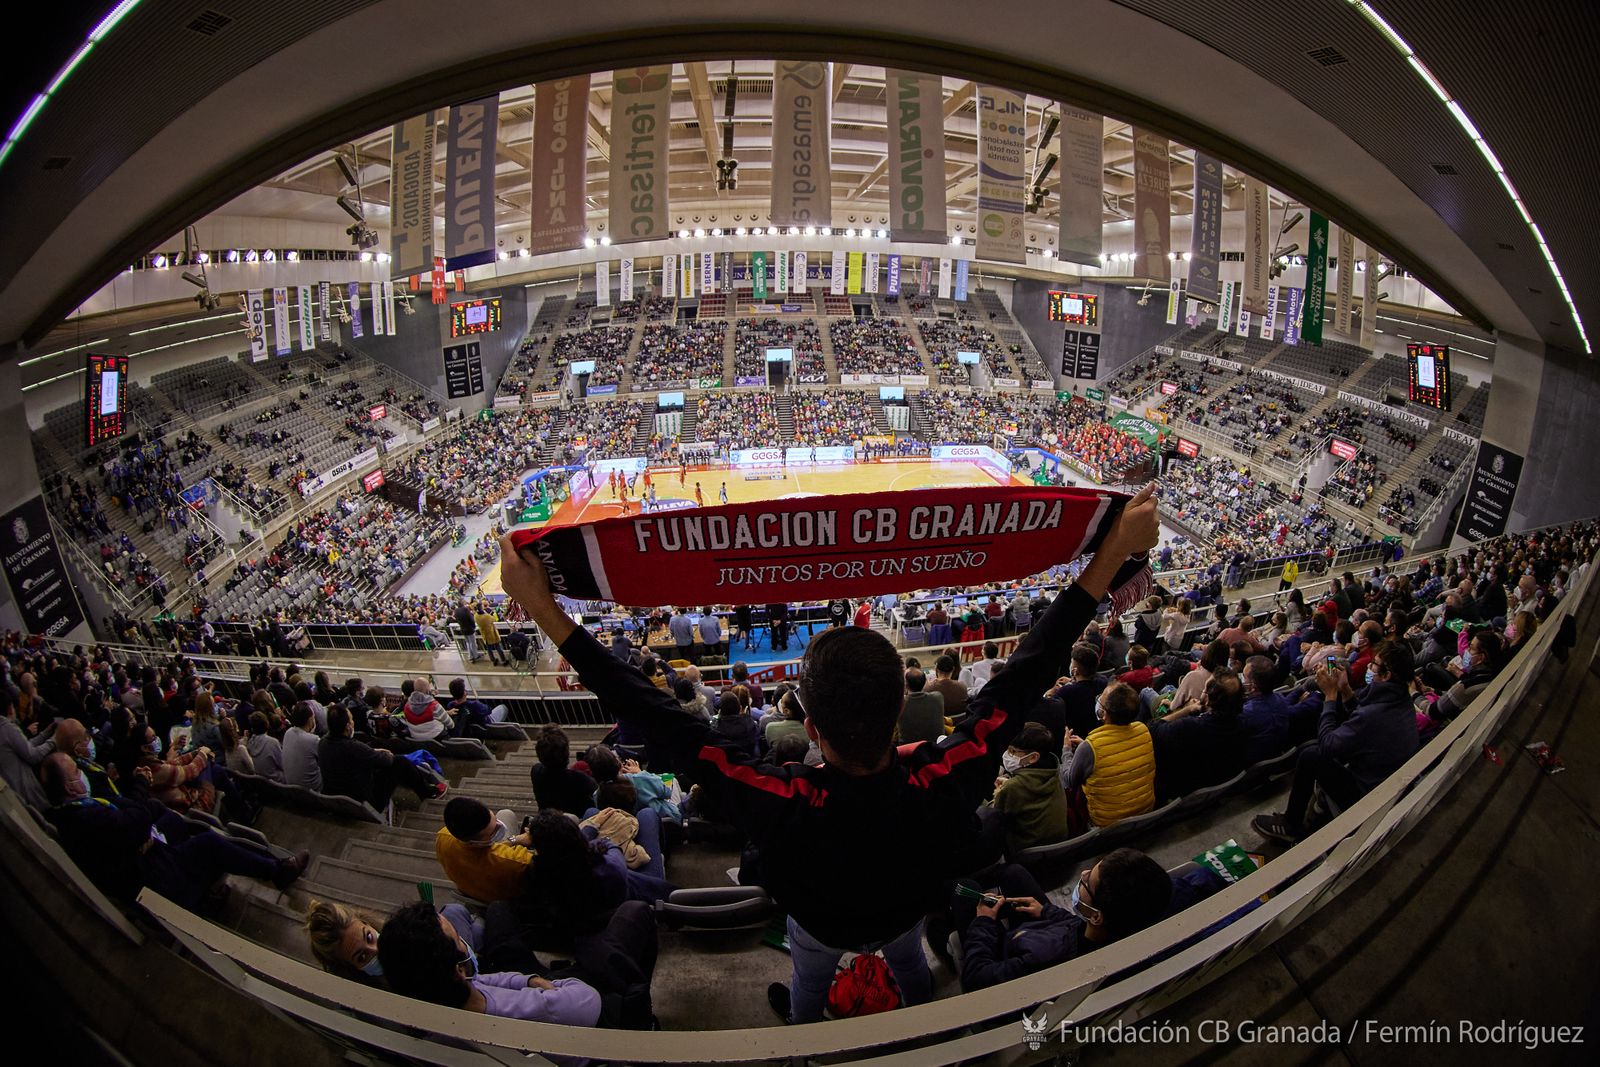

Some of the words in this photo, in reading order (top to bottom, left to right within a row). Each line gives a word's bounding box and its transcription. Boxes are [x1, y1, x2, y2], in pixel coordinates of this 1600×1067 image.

[890, 257, 899, 293] PULEVA
[303, 288, 312, 347] COVIRAN
[1222, 283, 1231, 330] COVIRAN
[1265, 287, 1276, 328] BERNER
[1289, 289, 1297, 316] Motor
[1313, 284, 1323, 326] RURAL
[252, 299, 264, 351] Jeep
[1182, 351, 1199, 361] IDEAL
[1220, 360, 1240, 370] IDEAL
[1300, 379, 1325, 395] IDEAL
[1340, 392, 1364, 406] IDEAL
[1368, 402, 1395, 416] IDEAL
[1399, 412, 1428, 429] IDEAL
[1445, 429, 1475, 447] IDEAL
[634, 509, 837, 552] FUNDACION
[853, 506, 897, 544] CB
[909, 499, 1063, 541] GRANADA
[715, 563, 812, 587] JUNTOS
[816, 562, 864, 580] POR
[870, 557, 905, 577] UN
[910, 549, 988, 573] SUEÑO
